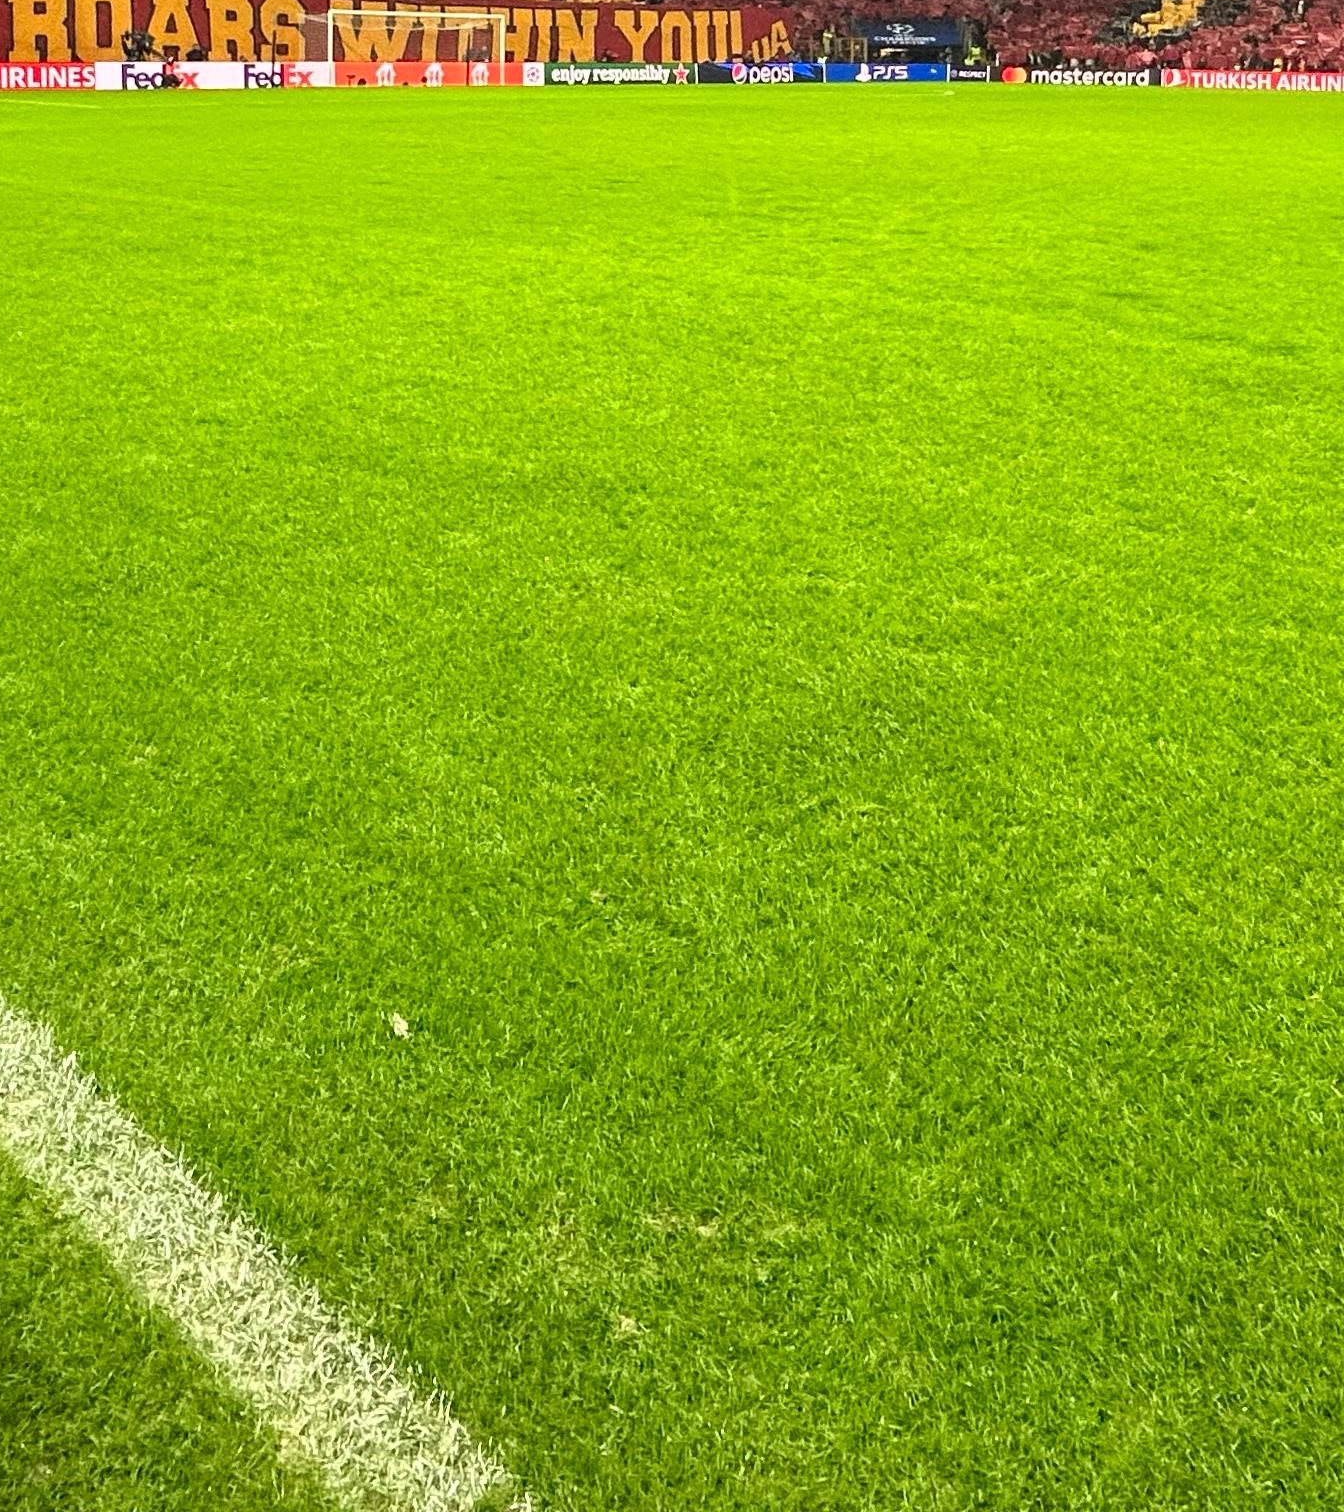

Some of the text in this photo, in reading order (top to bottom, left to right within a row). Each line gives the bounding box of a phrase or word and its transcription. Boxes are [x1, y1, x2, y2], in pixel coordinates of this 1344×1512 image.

[614, 8, 743, 63] YOU!
[121, 63, 313, 89] Fedx FedEx
[551, 64, 670, 85] enjoy responsibly
[749, 63, 793, 84] pepsi
[873, 65, 908, 80] PS5
[1031, 65, 1149, 87] mastercard
[1191, 72, 1272, 90] TURKISH
